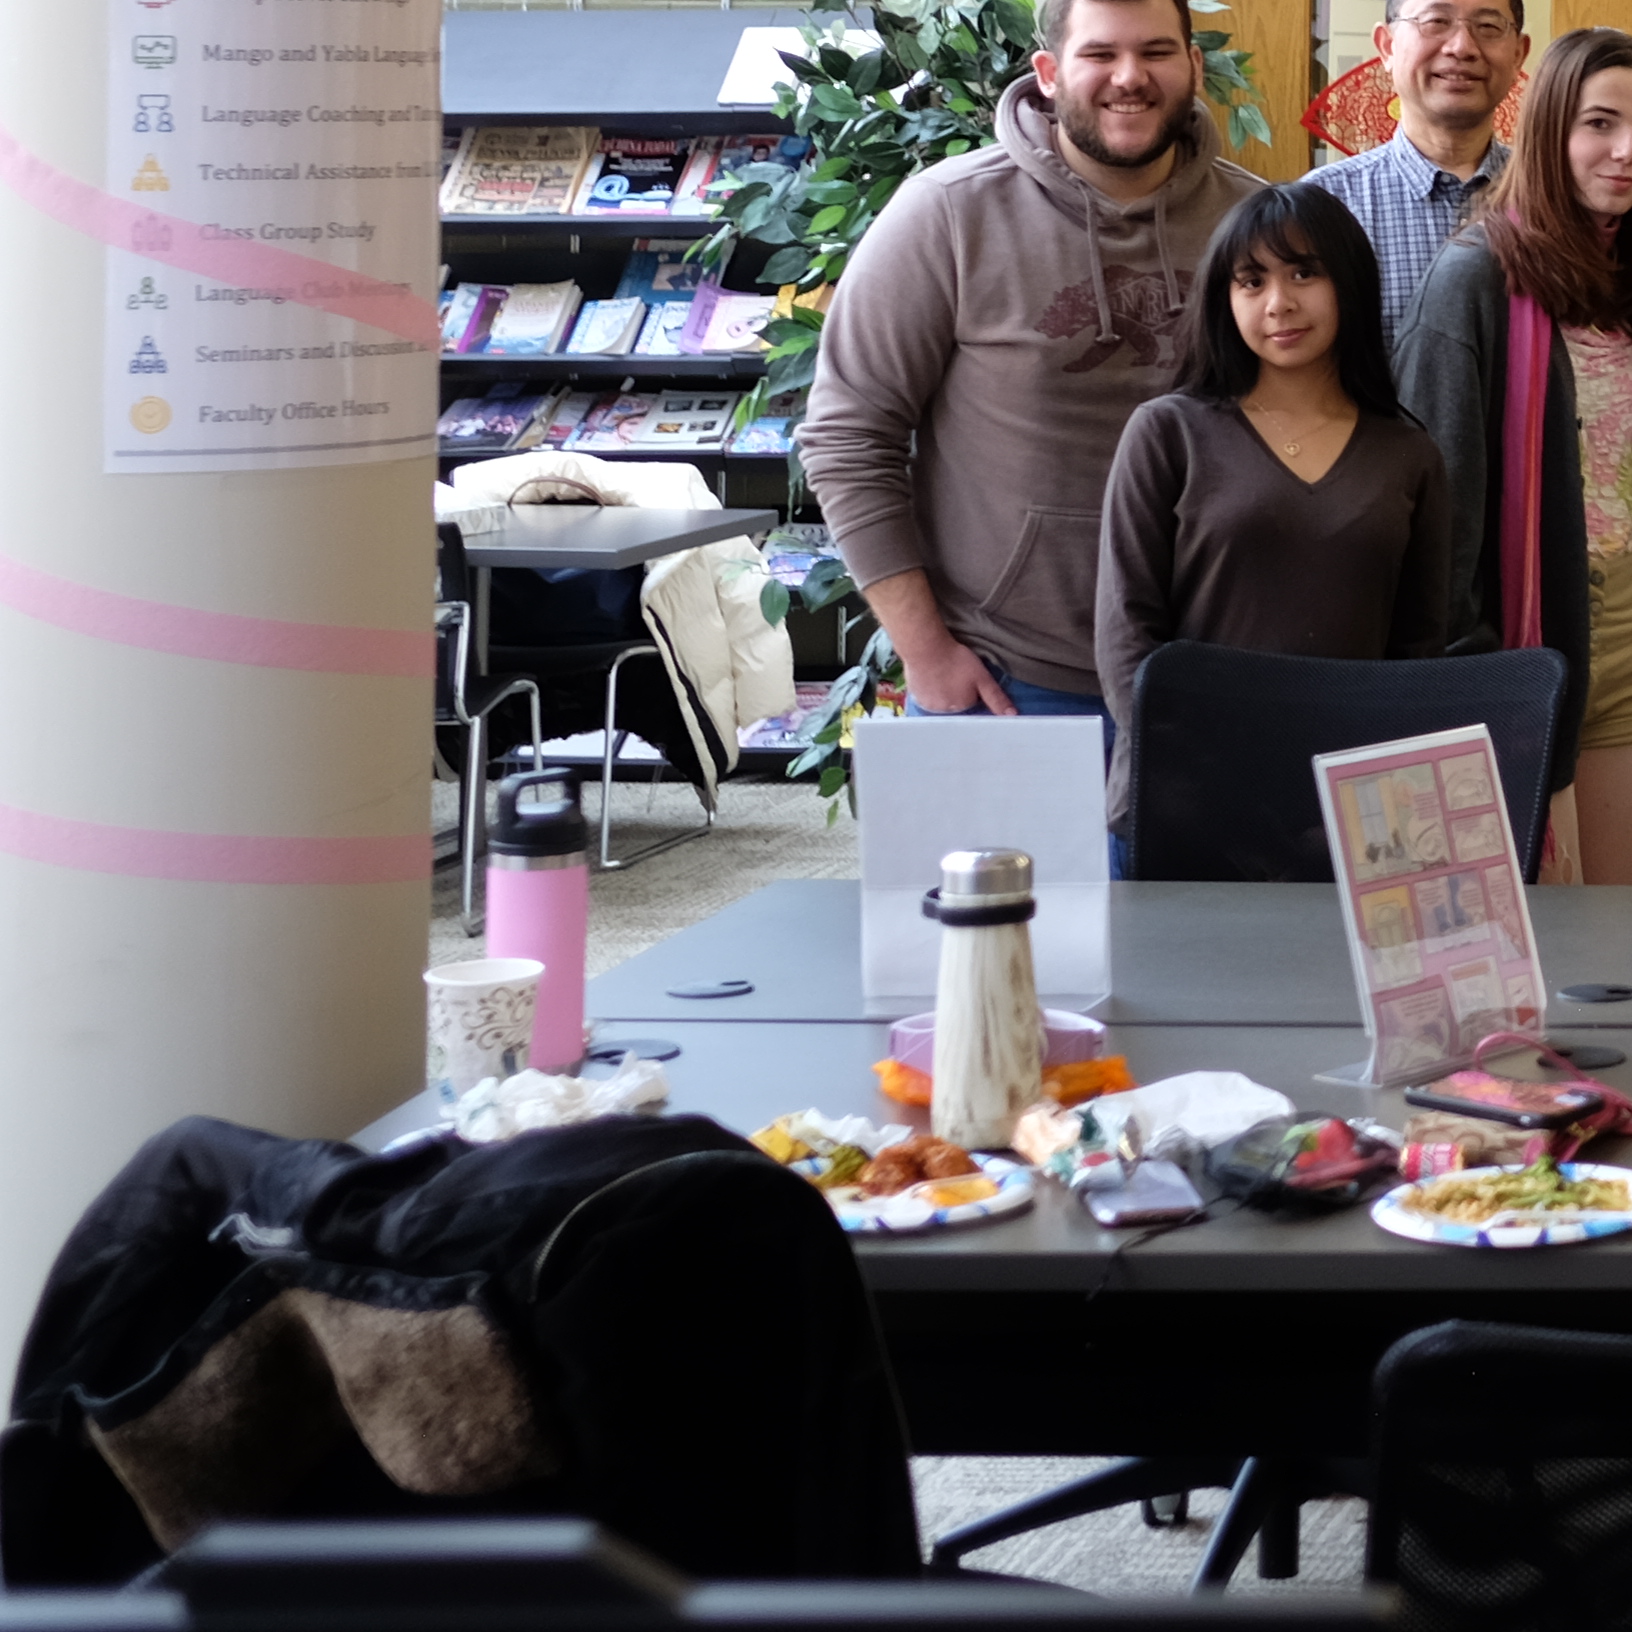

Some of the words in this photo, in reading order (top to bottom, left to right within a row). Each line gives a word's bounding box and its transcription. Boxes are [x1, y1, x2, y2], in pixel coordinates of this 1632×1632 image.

[202, 44, 274, 66] Mango
[278, 44, 317, 63] and
[201, 106, 302, 128] Language
[306, 106, 385, 127] Coaching
[198, 163, 300, 182] Technical
[305, 164, 393, 181] Assistance
[198, 223, 255, 242] Class
[259, 223, 323, 244] Group
[327, 222, 376, 242] Study
[195, 280, 296, 310] Language
[195, 344, 295, 364] Seminars
[299, 343, 335, 361] and
[199, 403, 276, 426] Faculty
[281, 402, 338, 421] Office
[342, 398, 390, 417] Hours
